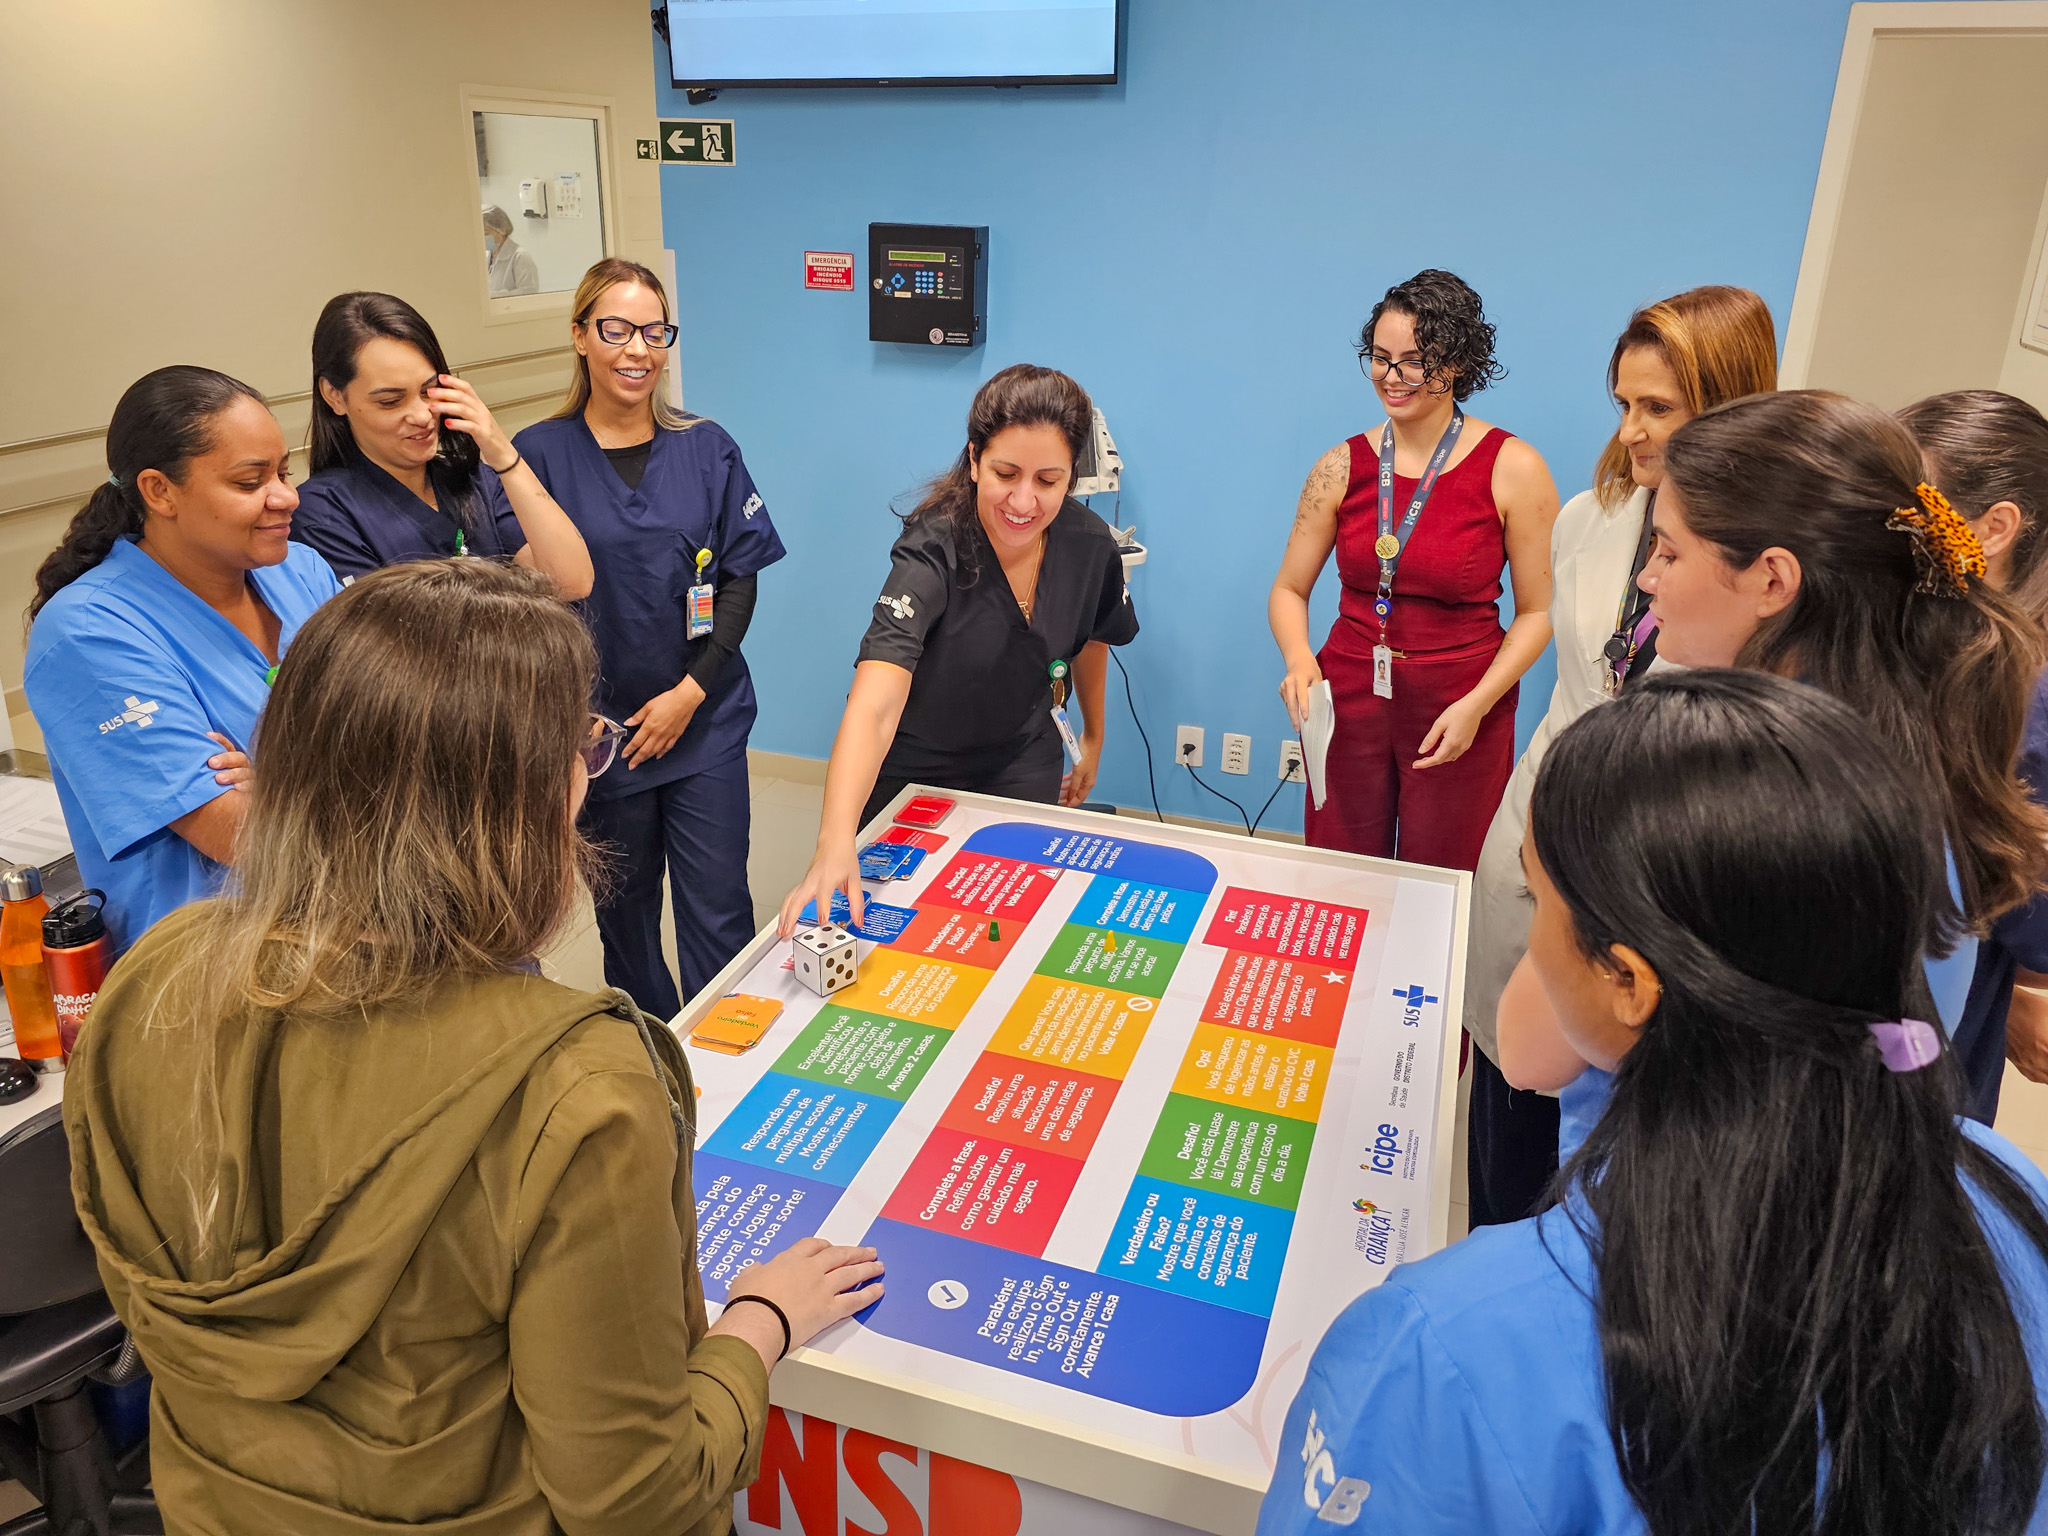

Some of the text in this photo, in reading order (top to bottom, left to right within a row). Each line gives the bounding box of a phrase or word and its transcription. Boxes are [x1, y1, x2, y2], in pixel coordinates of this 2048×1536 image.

[1381, 462, 1392, 487] HCB
[742, 492, 763, 520] HCB
[1404, 499, 1422, 526] HCB
[878, 595, 893, 605] SUS
[98, 715, 124, 735] SUS
[1042, 836, 1063, 857] Desafio!
[944, 866, 969, 890] Atenção!
[922, 913, 962, 953] Verdadeiro ou
[945, 926, 967, 946] Falso?
[955, 922, 987, 955] Prepare-se!
[1223, 909, 1239, 923] Fim!
[1403, 1007, 1421, 1028] SUS
[796, 1015, 850, 1071] Excelente! Você
[815, 1025, 855, 1064] identificou
[823, 1026, 867, 1075] corretamente
[837, 1026, 881, 1075] paciente com
[843, 1061, 867, 1085] nome
[861, 1027, 893, 1062] completo
[868, 1040, 897, 1069] data de
[875, 1037, 913, 1080] nascimento.
[886, 1034, 936, 1092] Avance 2 casas.
[1195, 1049, 1212, 1069] Ops!
[1393, 1051, 1405, 1082] GOVERNO DO
[1402, 1042, 1416, 1084] DISTRITO FEDERAL
[973, 1076, 1004, 1112] Desafio!
[986, 1073, 1025, 1124] Resolva uma
[1010, 1085, 1037, 1119] situação
[1023, 1086, 1056, 1134] relacionada
[1039, 1080, 1078, 1141] uma das metas
[1057, 1086, 1095, 1142] de segurança.
[740, 1088, 801, 1152] Responda uma
[765, 1097, 813, 1151] pergunta de
[774, 1093, 837, 1164] múltipla escolha.
[797, 1106, 846, 1158] Mostre seus
[812, 1101, 868, 1171] conhecimentos!
[1176, 1122, 1202, 1160] Desafio!
[1188, 1111, 1225, 1180] Você está quase
[1209, 1120, 1241, 1181] lá! Demonstre
[1230, 1121, 1260, 1189] sua experiência
[1248, 1123, 1278, 1196] com um caso do
[1270, 1143, 1293, 1183] dia a dia.
[1365, 1123, 1403, 1176] icipe
[704, 1175, 732, 1200] pela
[723, 1187, 743, 1203] do
[727, 1183, 768, 1227] começa
[775, 1188, 806, 1222] sorte!
[919, 1140, 978, 1221] Complete a frase.
[944, 1154, 989, 1214] Reflita sobre
[960, 1147, 1014, 1231] como garantir um
[985, 1161, 1027, 1225] cuidado mais
[1012, 1179, 1039, 1214] seguro.
[709, 1193, 781, 1280] agora! Jogue o
[750, 1247, 763, 1257] e
[753, 1222, 782, 1247] boa
[1119, 1192, 1161, 1265] Verdadeiro ou
[1148, 1215, 1173, 1252] Falso?
[1155, 1197, 1198, 1282] Mostre que você
[1179, 1215, 1210, 1270] domina os
[1197, 1213, 1228, 1281] conceitos de
[1213, 1216, 1245, 1288] segurança do
[1354, 1217, 1370, 1253] HOSPITAL DA
[1364, 1214, 1396, 1266] CRIANÇA
[1234, 1232, 1258, 1281] paciente.
[976, 1277, 1018, 1338] Parabéns!
[992, 1279, 1035, 1346] Sua equipe
[1007, 1274, 1056, 1361] realizou o Sign
[1022, 1281, 1070, 1364] In, Time Out e
[1046, 1298, 1081, 1353] Sign Out
[1060, 1290, 1104, 1374] corretamente.
[1076, 1294, 1120, 1379] Avance 1 casa
[1300, 1407, 1371, 1526] HCB
